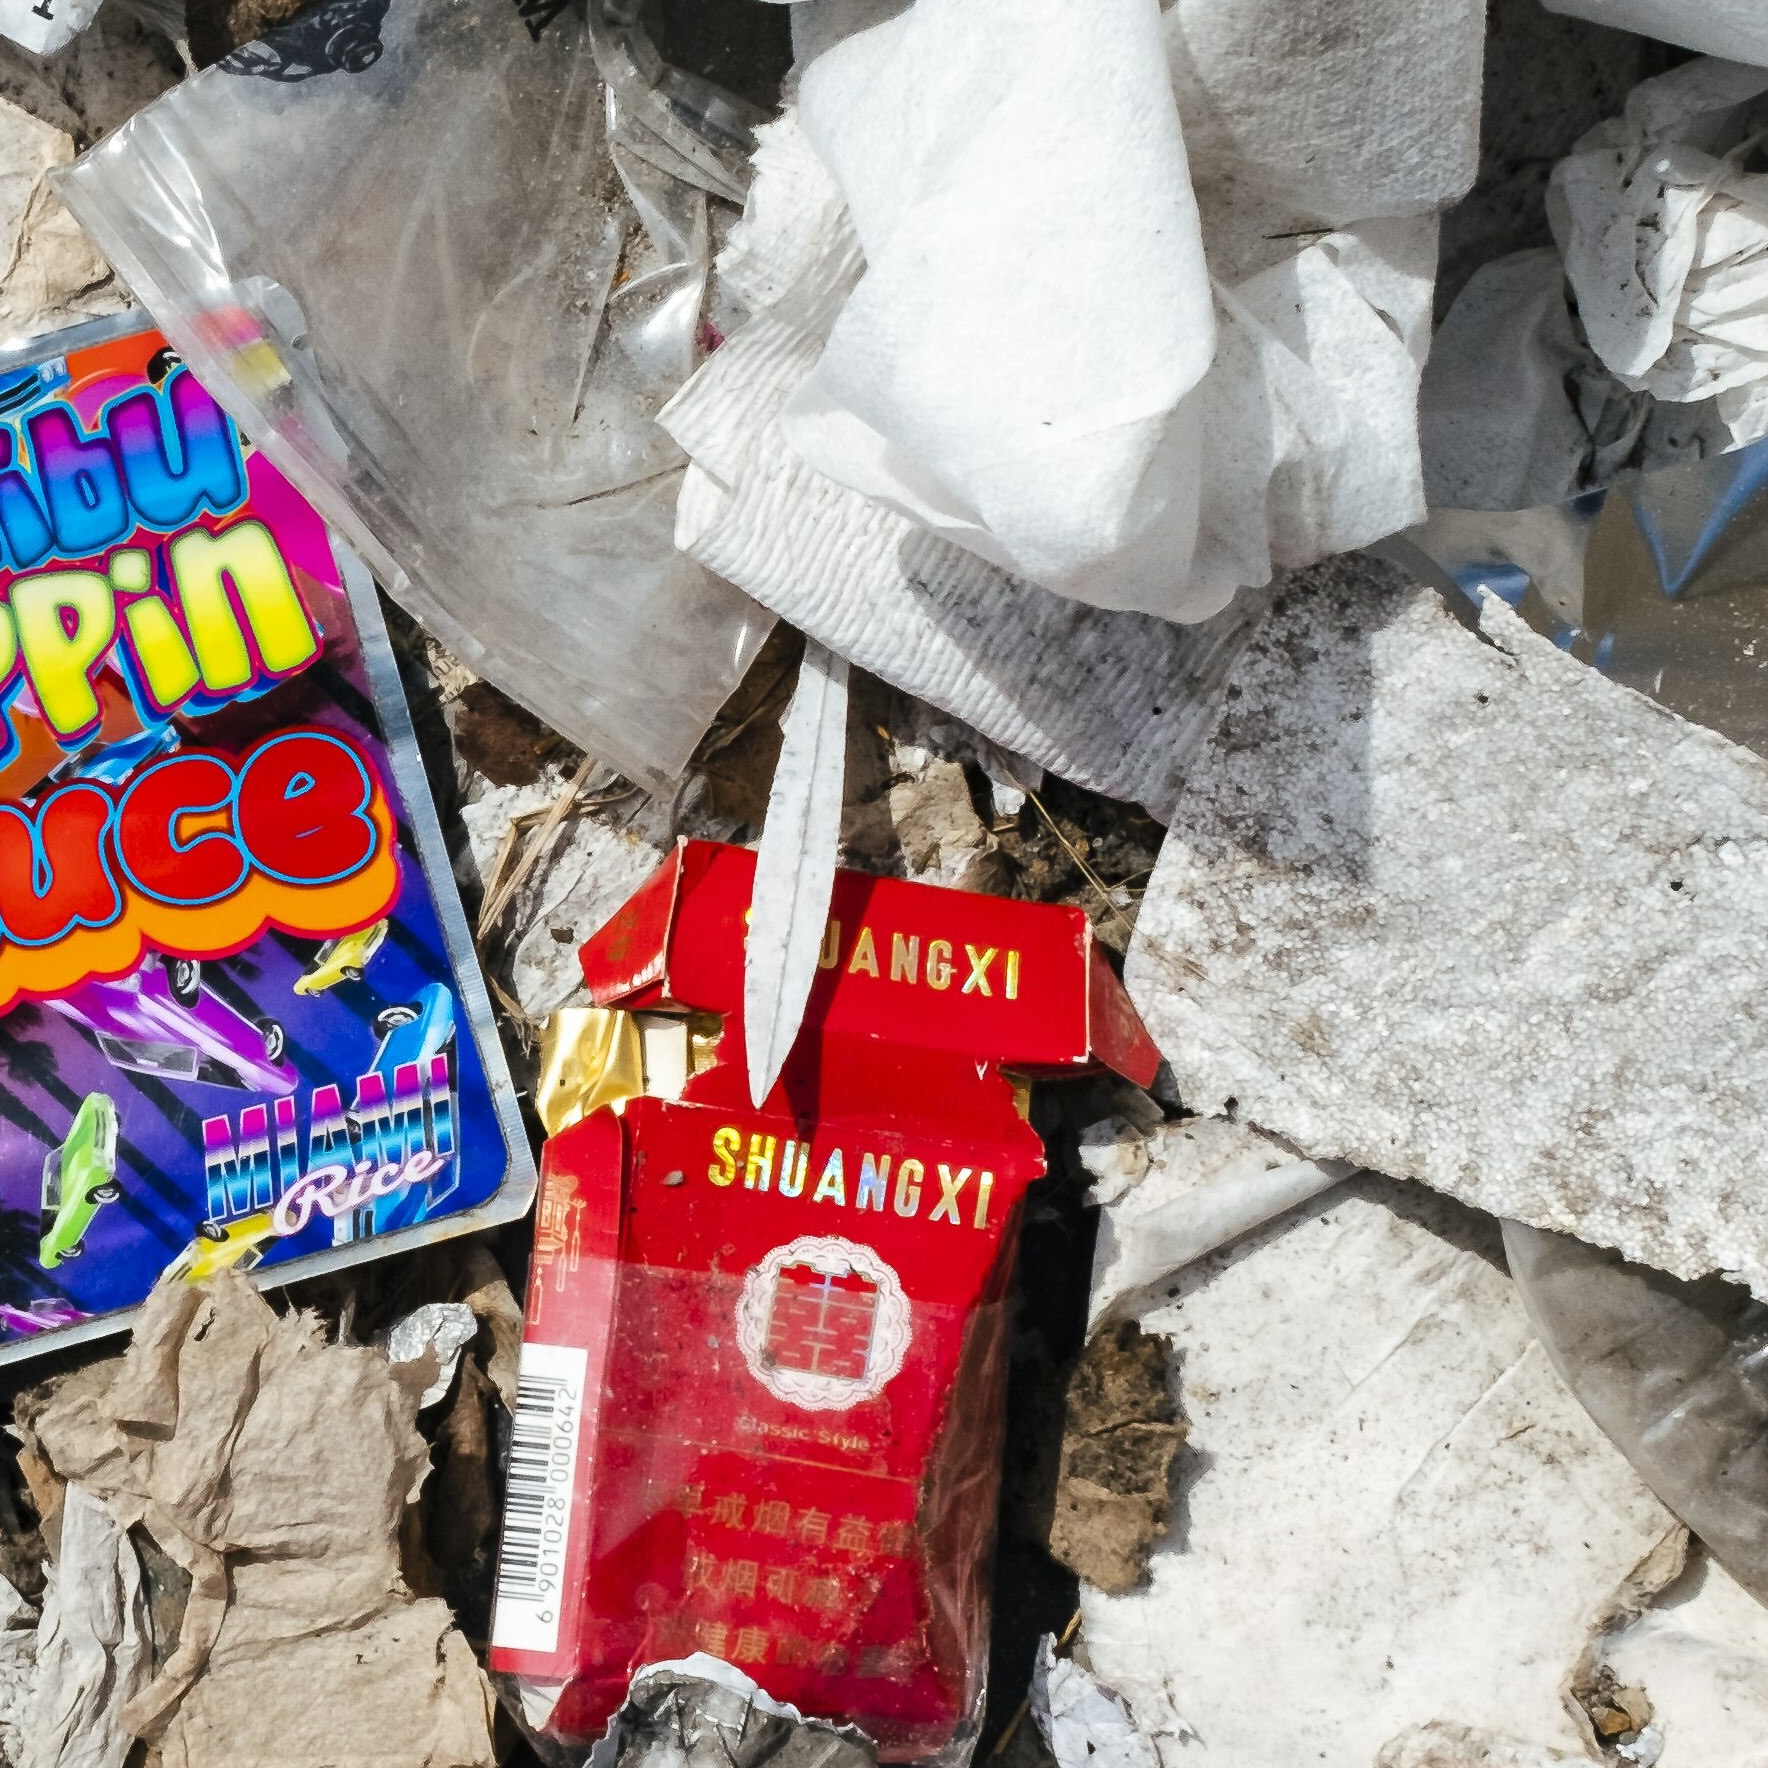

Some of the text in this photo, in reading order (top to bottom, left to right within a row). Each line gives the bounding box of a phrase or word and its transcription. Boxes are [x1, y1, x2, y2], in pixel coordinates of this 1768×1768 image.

[743, 906, 1020, 1001] UANGXI
[202, 1054, 455, 1222] MIAMI
[708, 1126, 995, 1230] SHUANGXI
[271, 1148, 448, 1236] Rice
[818, 1425, 871, 1453] Style
[535, 1387, 579, 1625] 6 901028 000642
